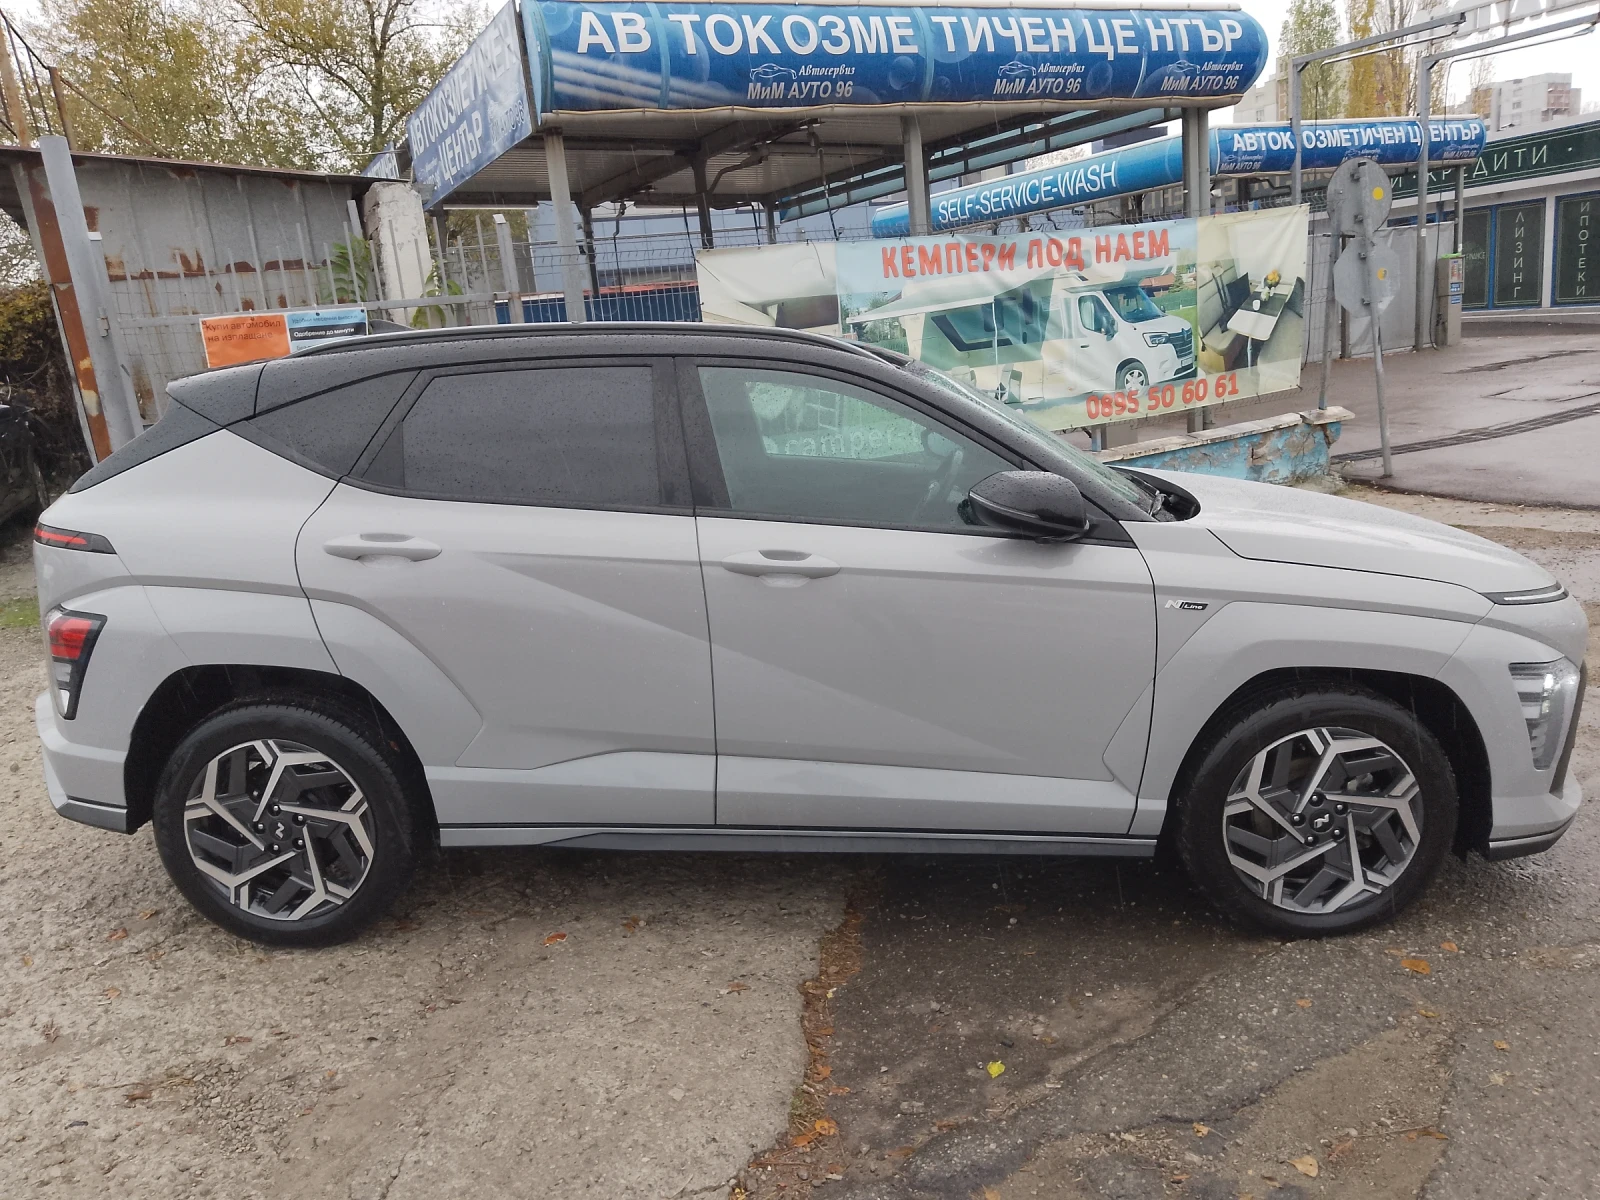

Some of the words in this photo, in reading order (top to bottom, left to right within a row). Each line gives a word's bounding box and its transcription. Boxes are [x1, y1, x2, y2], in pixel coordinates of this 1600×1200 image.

[798, 64, 856, 79] Автосервиз
[1038, 62, 1085, 77] Автосервиз
[1201, 61, 1243, 74] Автосервиз
[747, 82, 784, 100] МиМ
[788, 81, 831, 99] АУТО
[835, 80, 853, 97] 96
[993, 78, 1025, 95] МиМ
[1026, 77, 1063, 94] АУТО
[1065, 77, 1081, 93] 96
[1160, 76, 1188, 91] МиМ
[1189, 75, 1223, 91] АУТО
[1223, 75, 1239, 90] 96
[438, 110, 484, 185] ЦЕНТЪР
[881, 242, 1017, 278] КЕМПЕРИ
[1026, 236, 1085, 271] ПОД
[1095, 228, 1170, 264] НАЕМ
[1513, 211, 1524, 298] ЛИЗИНГ
[1576, 202, 1590, 296] ИПОТЕКИ
[206, 323, 229, 332] Купи
[231, 319, 281, 330] автомобил
[221, 331, 274, 341] изплащане
[1086, 390, 1139, 419] 0895
[1147, 383, 1175, 411] 50
[1181, 378, 1208, 404] 60
[1214, 372, 1239, 398] 61
[1164, 599, 1183, 609] N
